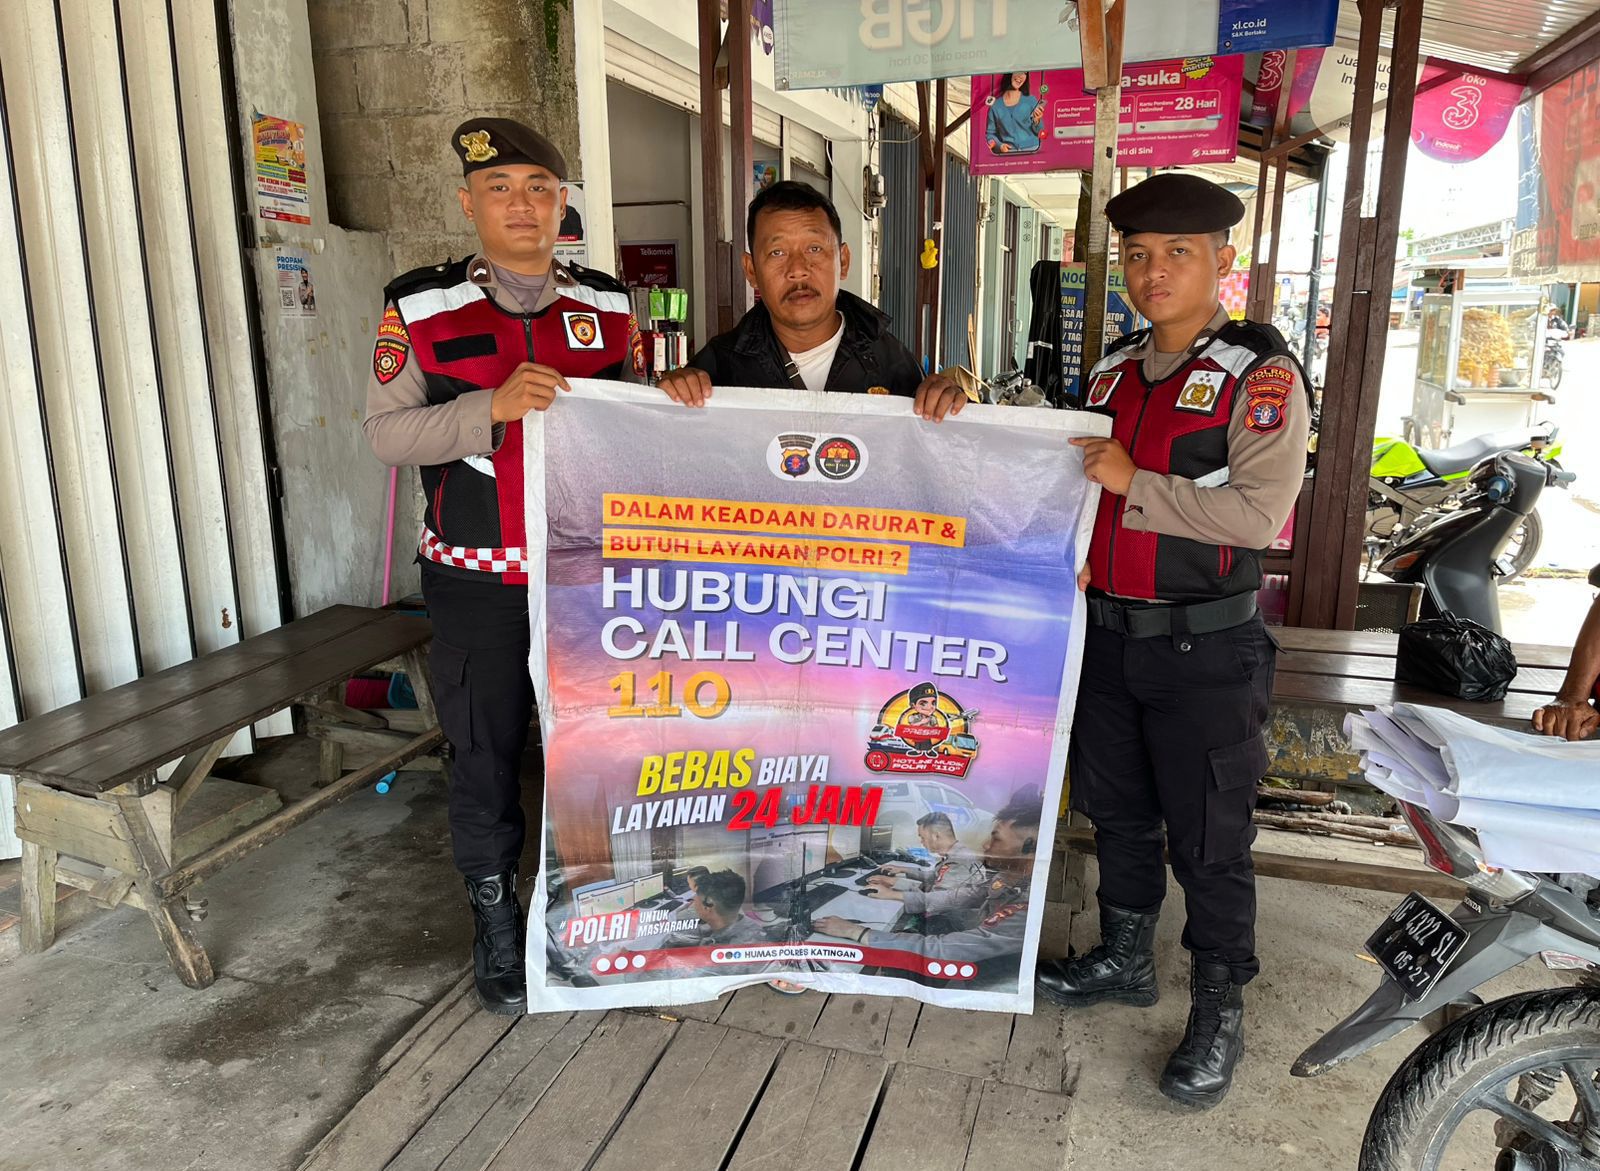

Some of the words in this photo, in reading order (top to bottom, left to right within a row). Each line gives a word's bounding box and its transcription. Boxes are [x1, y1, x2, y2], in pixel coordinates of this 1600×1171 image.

[1232, 18, 1267, 31] xl.co.id
[1337, 54, 1359, 67] Jua
[1121, 69, 1181, 88] a-suka
[1461, 72, 1487, 87] Toko
[1119, 104, 1132, 114] ari
[1175, 97, 1194, 111] 28
[1196, 98, 1217, 109] Hari
[1129, 146, 1137, 155] di
[640, 247, 673, 256] Telkomsel
[276, 256, 303, 264] PROPAM
[610, 500, 694, 521] DALAM
[702, 505, 815, 528] KEADAAN
[823, 512, 935, 535] DARURAT
[940, 522, 956, 540] &
[610, 535, 690, 554] BUTUH
[697, 540, 809, 561] LAYANAN
[816, 545, 883, 566] POLRI
[603, 567, 887, 621] HUBUNGI
[601, 616, 756, 661] CALL
[768, 622, 1008, 683] CENTER
[607, 671, 731, 719] 110
[934, 759, 965, 768] MUDIK
[636, 748, 755, 796] BEBAS
[756, 755, 829, 786] BIAYA
[611, 794, 727, 835] LAYANAN
[726, 787, 783, 831] 24
[790, 784, 884, 827] JAM
[639, 909, 670, 924] UNTUK
[637, 918, 700, 938] MASYARAKAT
[1406, 909, 1442, 946] 4322
[1431, 931, 1457, 965] SL
[744, 949, 778, 959] HUMAS
[778, 948, 809, 957] POLRES
[810, 949, 856, 959] KATINGAN
